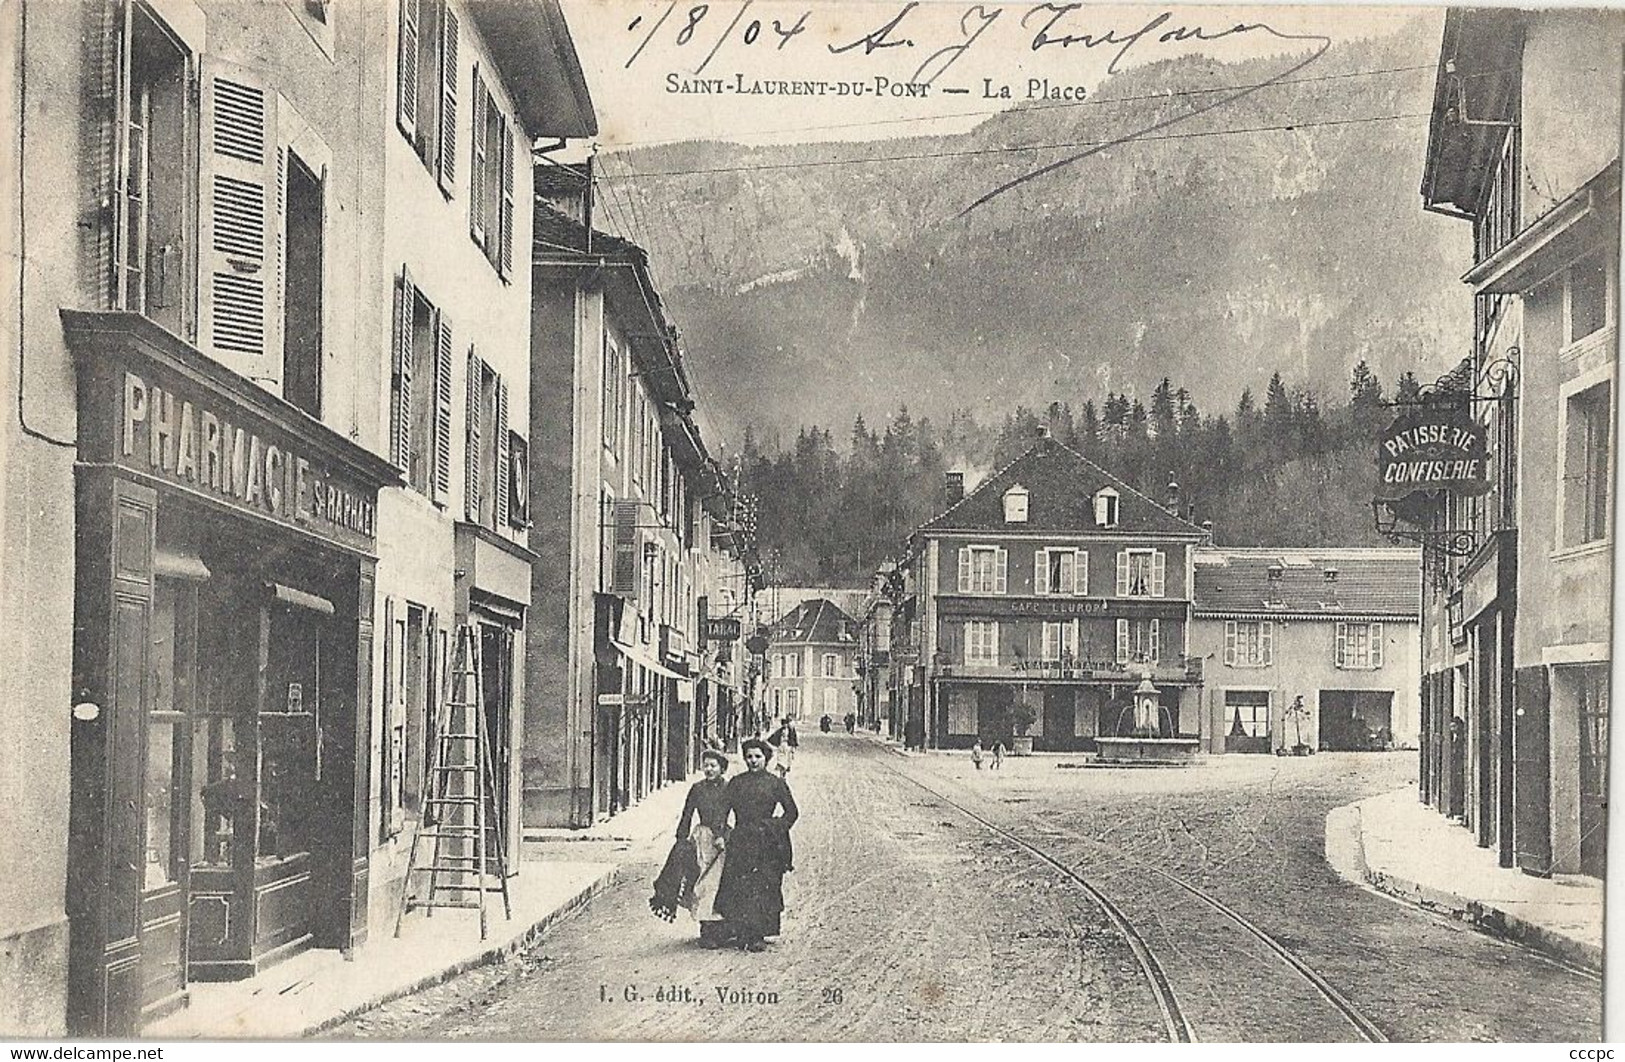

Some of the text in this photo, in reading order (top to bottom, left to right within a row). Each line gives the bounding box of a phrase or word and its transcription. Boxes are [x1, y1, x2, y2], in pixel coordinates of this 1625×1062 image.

[122, 371, 310, 517] PHARMACIE
[1384, 424, 1476, 458] PATISSERIE
[1384, 459, 1480, 483] CONFISERIE
